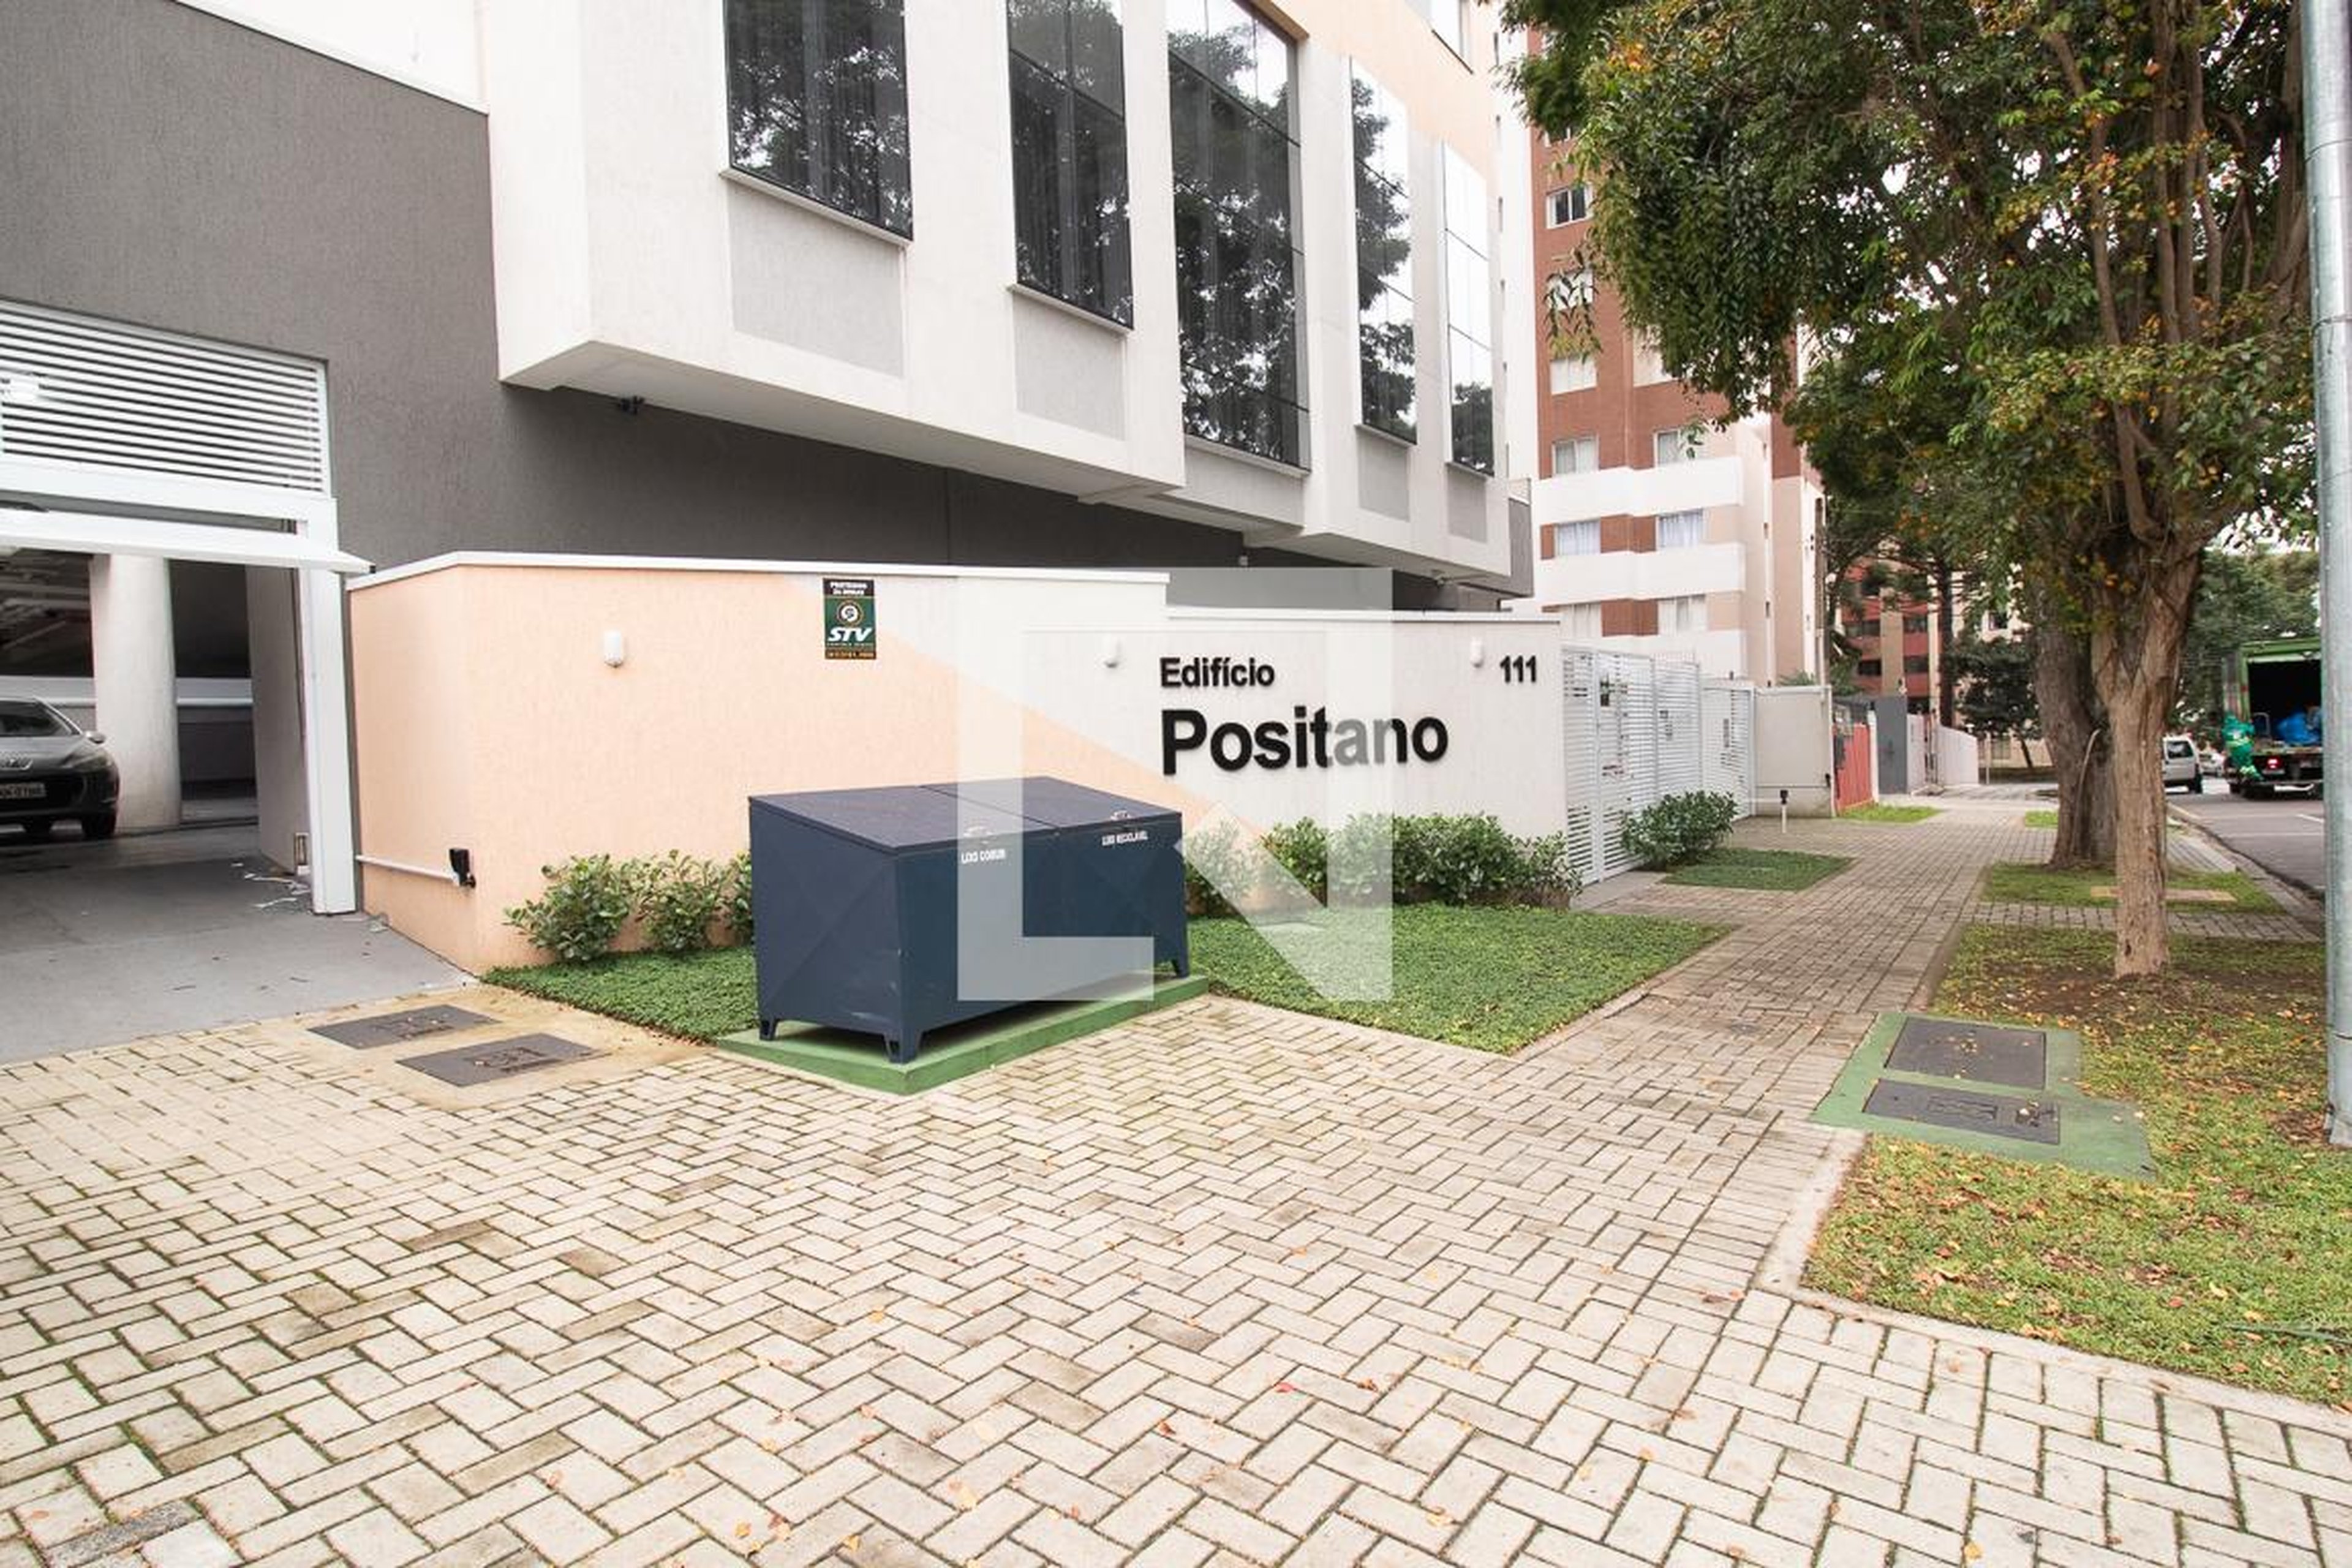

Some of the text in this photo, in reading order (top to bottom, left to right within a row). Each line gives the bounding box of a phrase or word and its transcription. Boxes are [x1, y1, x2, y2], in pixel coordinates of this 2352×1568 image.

[828, 627, 872, 641] STV
[1160, 657, 1275, 688] Edifício
[1500, 655, 1536, 684] 111
[1161, 706, 1449, 777] Positano
